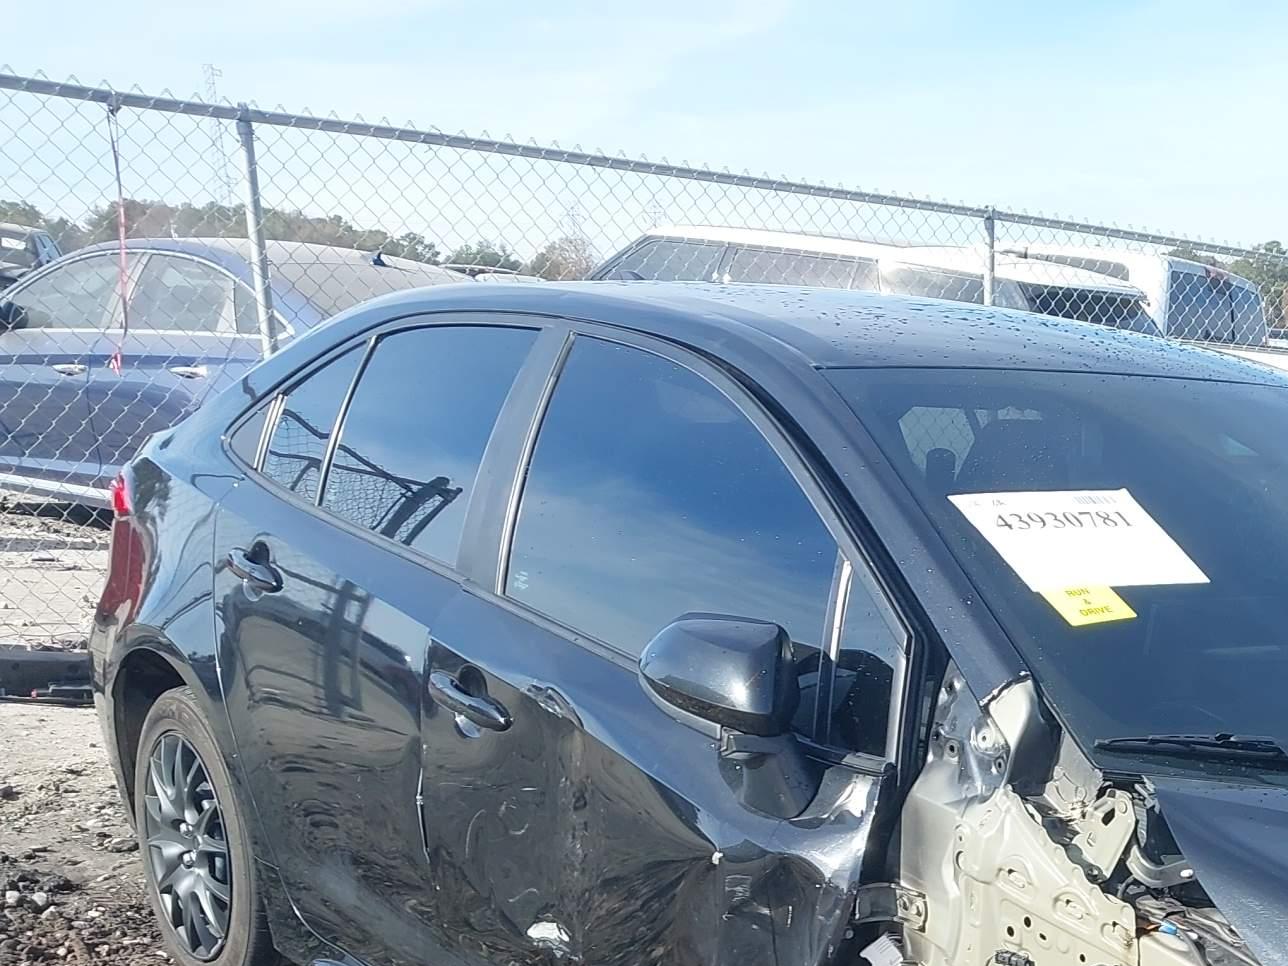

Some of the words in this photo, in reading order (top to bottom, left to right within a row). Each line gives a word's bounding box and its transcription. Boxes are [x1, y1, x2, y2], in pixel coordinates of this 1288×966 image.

[996, 511, 1133, 530] 43930781
[1065, 587, 1091, 597] RUN
[1079, 606, 1113, 616] DRIVE
